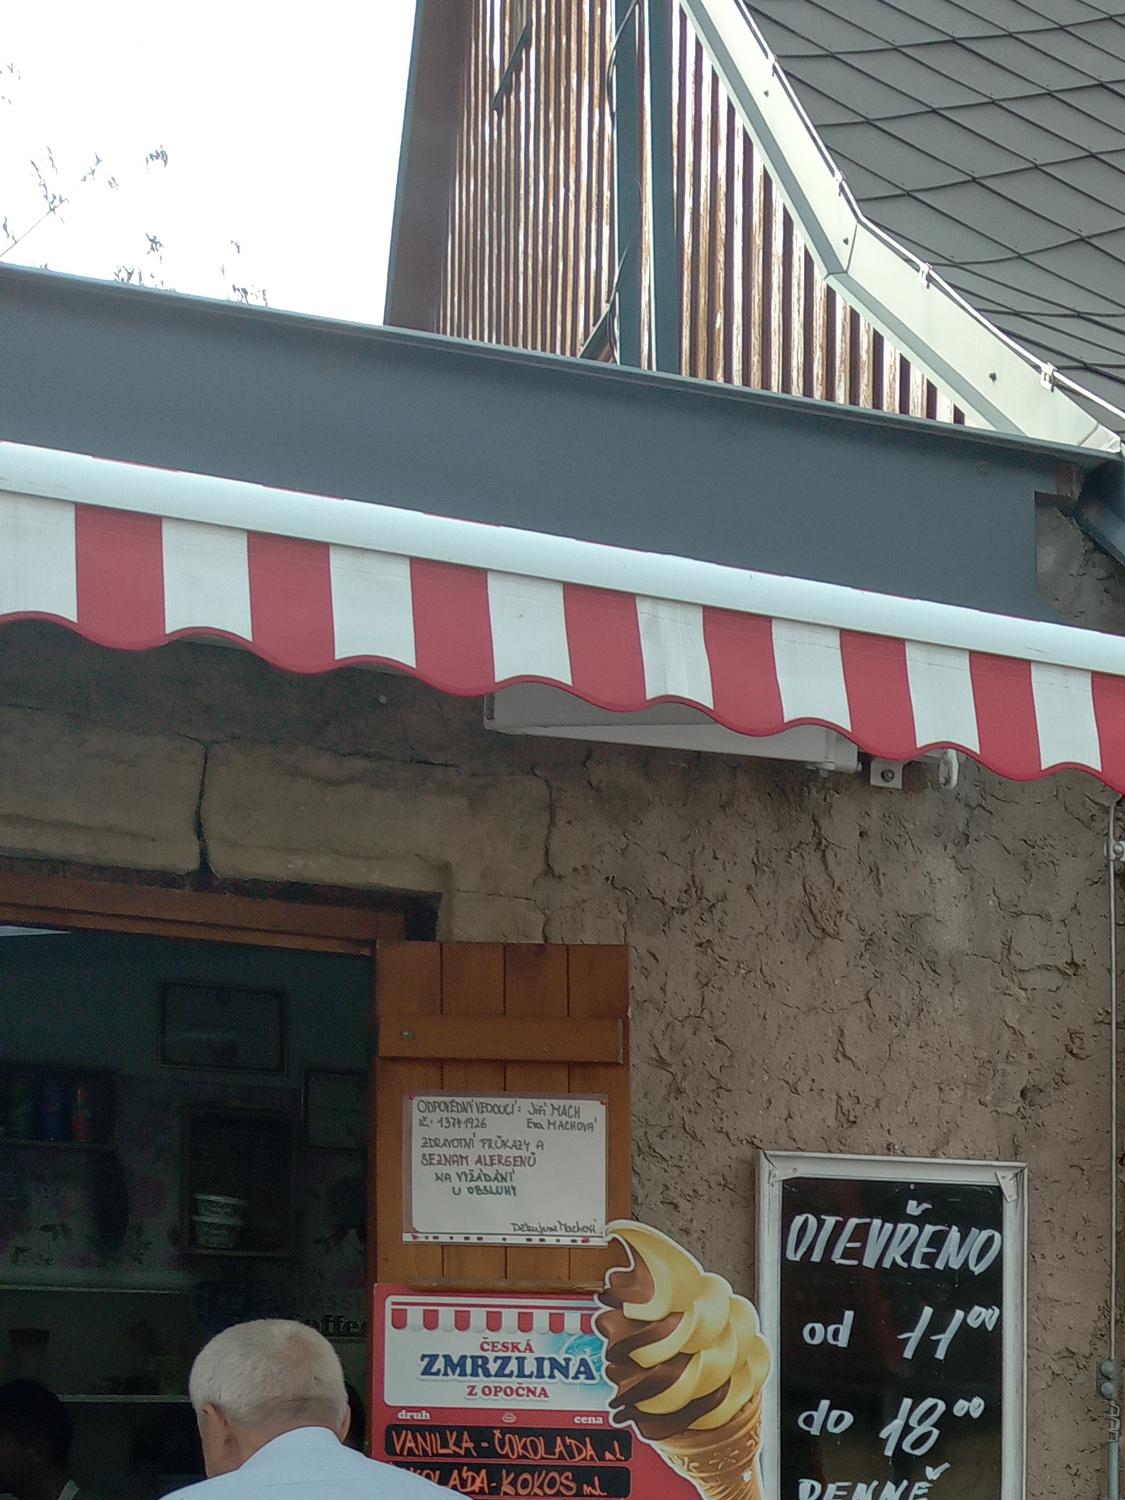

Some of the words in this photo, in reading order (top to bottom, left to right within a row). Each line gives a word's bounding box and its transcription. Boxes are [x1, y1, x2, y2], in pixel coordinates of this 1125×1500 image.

[550, 1103, 581, 1119] MACH
[535, 1139, 545, 1151] A
[420, 1152, 470, 1167] SEZNAM
[474, 1151, 537, 1168] ALERGENŮ
[434, 1171, 452, 1183] NA
[451, 1185, 462, 1196] U
[785, 1199, 1003, 1276] OTEVŘENO
[801, 1309, 856, 1349] od
[479, 1336, 535, 1354] ČESKÁ
[419, 1353, 597, 1380] ZMRZLINA
[466, 1384, 478, 1397] Z
[481, 1382, 550, 1399] OPOČNA
[397, 1409, 431, 1421] druh
[573, 1413, 605, 1425] cena
[796, 1398, 855, 1437] do
[391, 1429, 478, 1457] VANILKA
[501, 1469, 577, 1497] KOKOS
